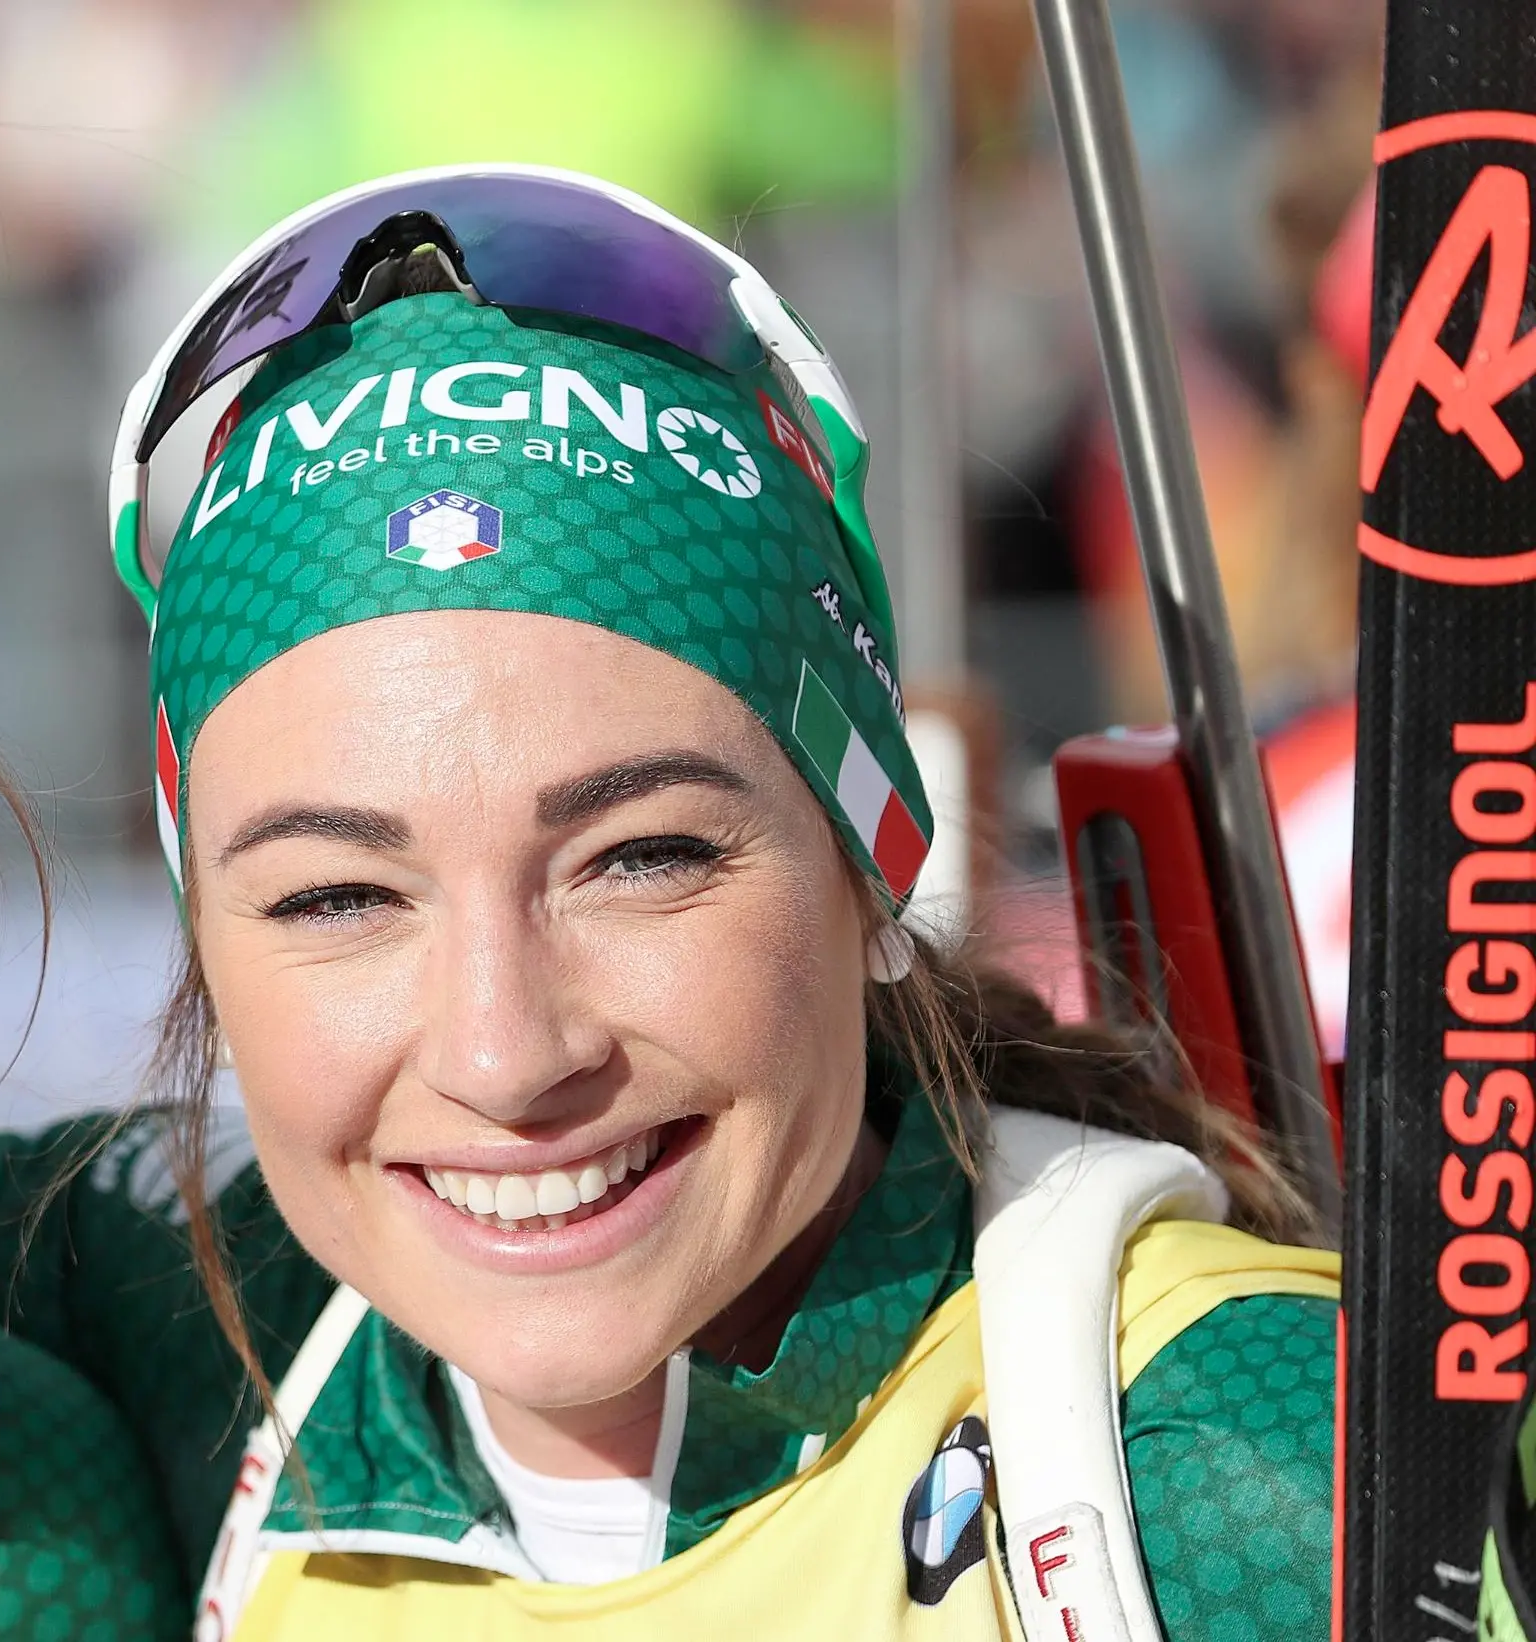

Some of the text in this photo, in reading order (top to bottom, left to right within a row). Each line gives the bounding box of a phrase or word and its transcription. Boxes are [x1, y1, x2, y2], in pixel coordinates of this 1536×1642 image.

[189, 361, 762, 540] LIVIGNO
[290, 434, 387, 497] feel
[404, 430, 502, 458] the
[522, 434, 636, 486] alps
[409, 494, 482, 517] FISI
[1434, 680, 1536, 1402] ROSSIGNOL
